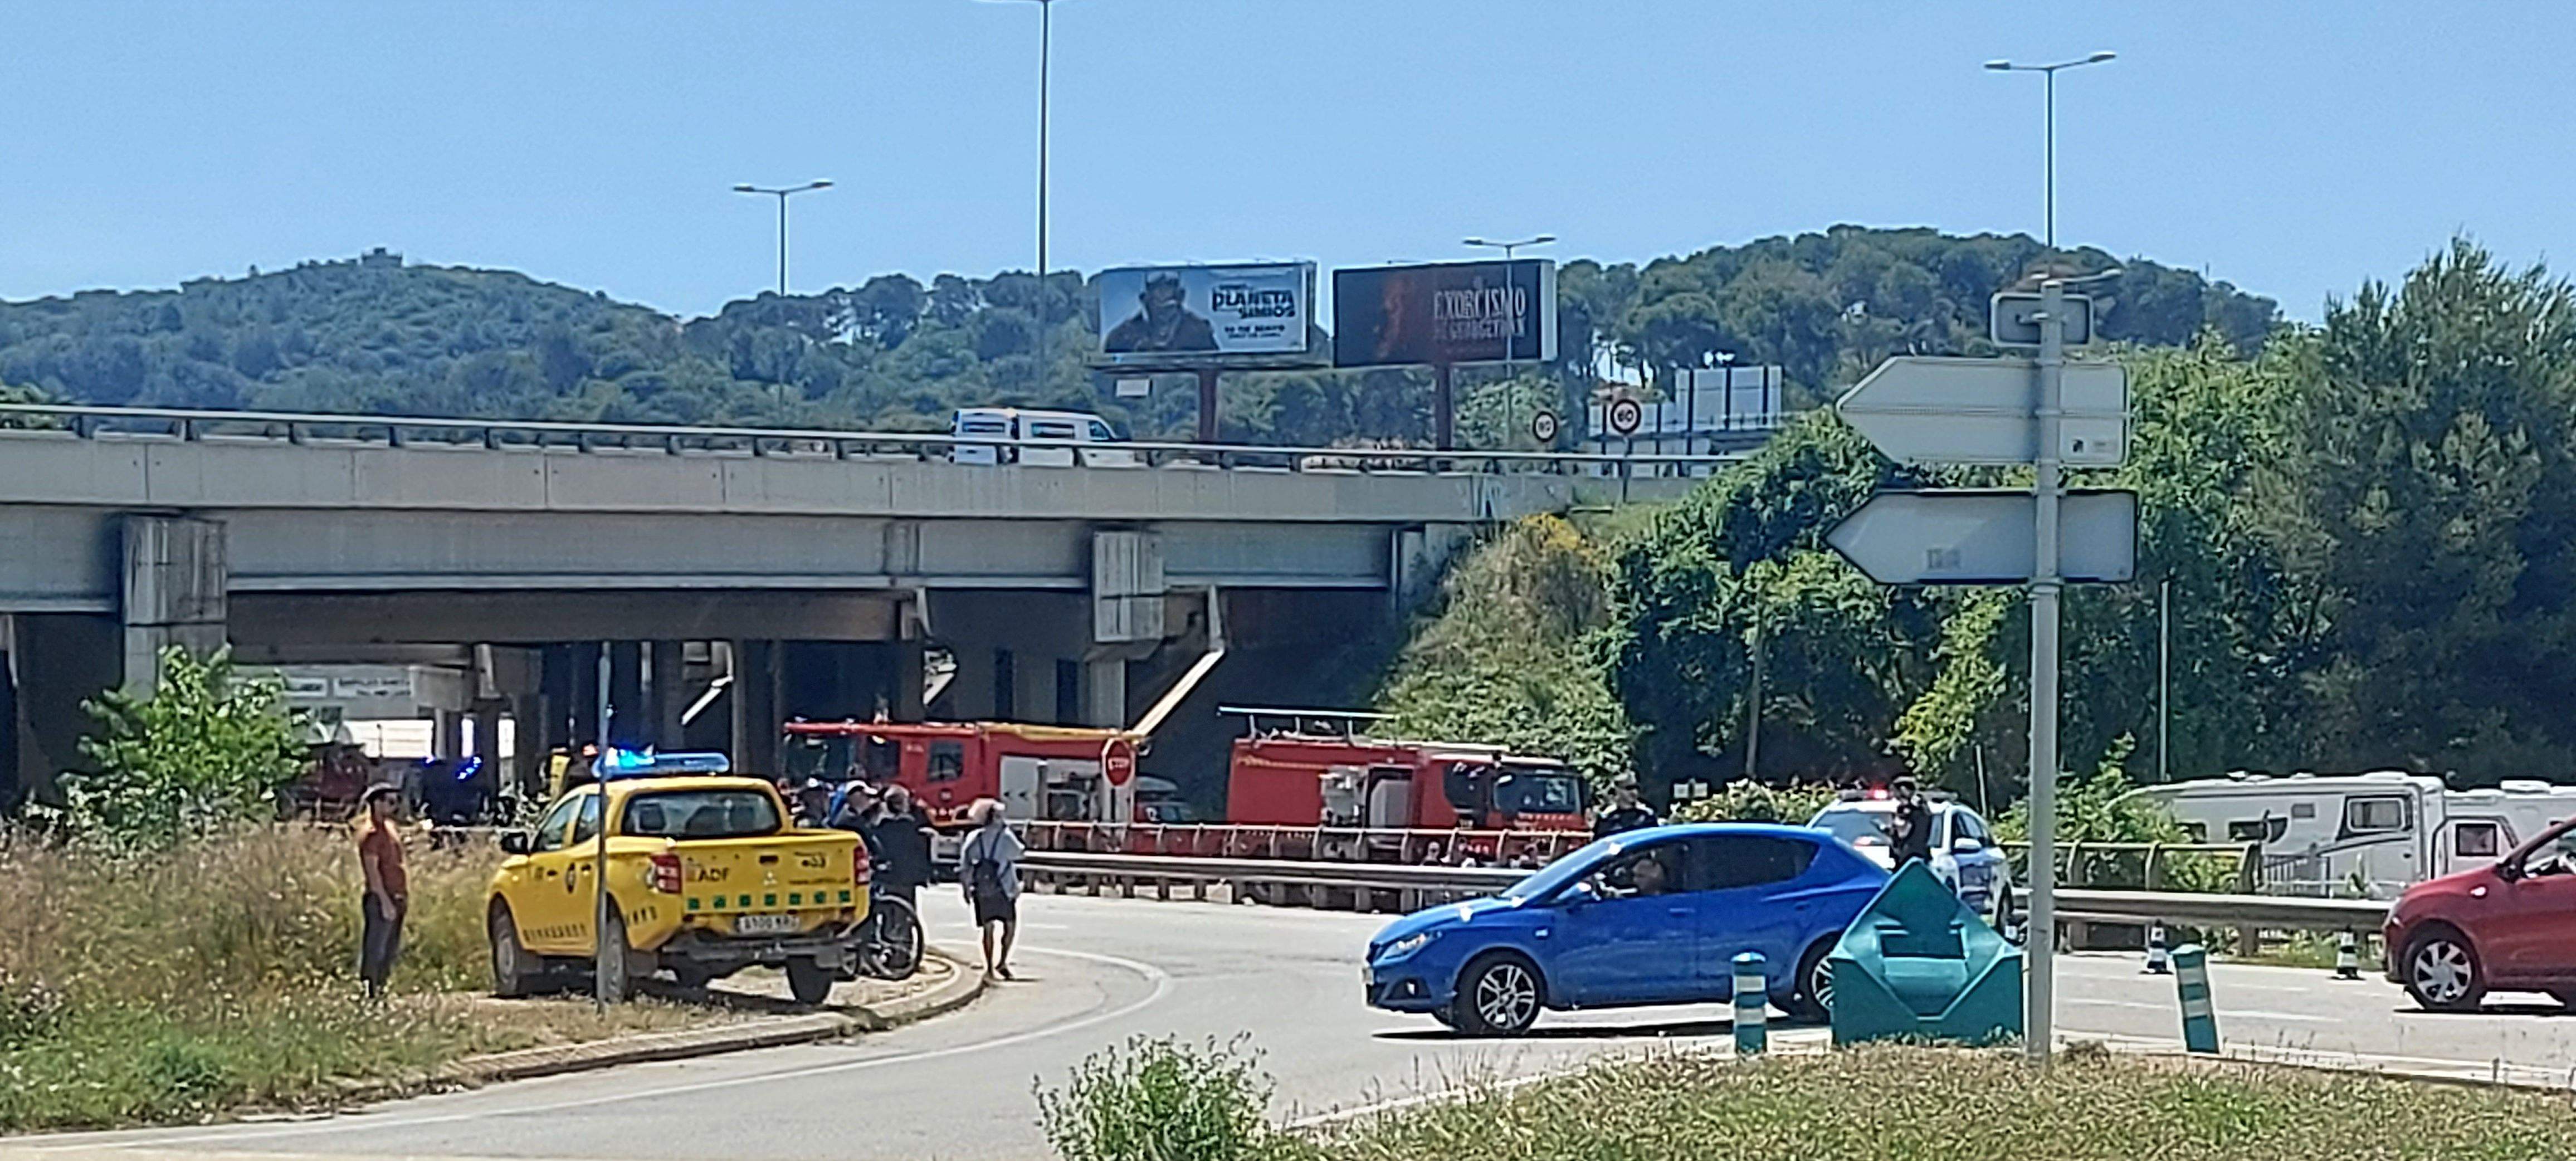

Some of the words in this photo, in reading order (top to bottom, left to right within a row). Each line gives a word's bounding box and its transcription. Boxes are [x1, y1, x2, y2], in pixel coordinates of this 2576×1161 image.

[1434, 287, 1526, 319] EXORCISMO
[1617, 409, 1633, 422] 60
[698, 867, 729, 882] ADF
